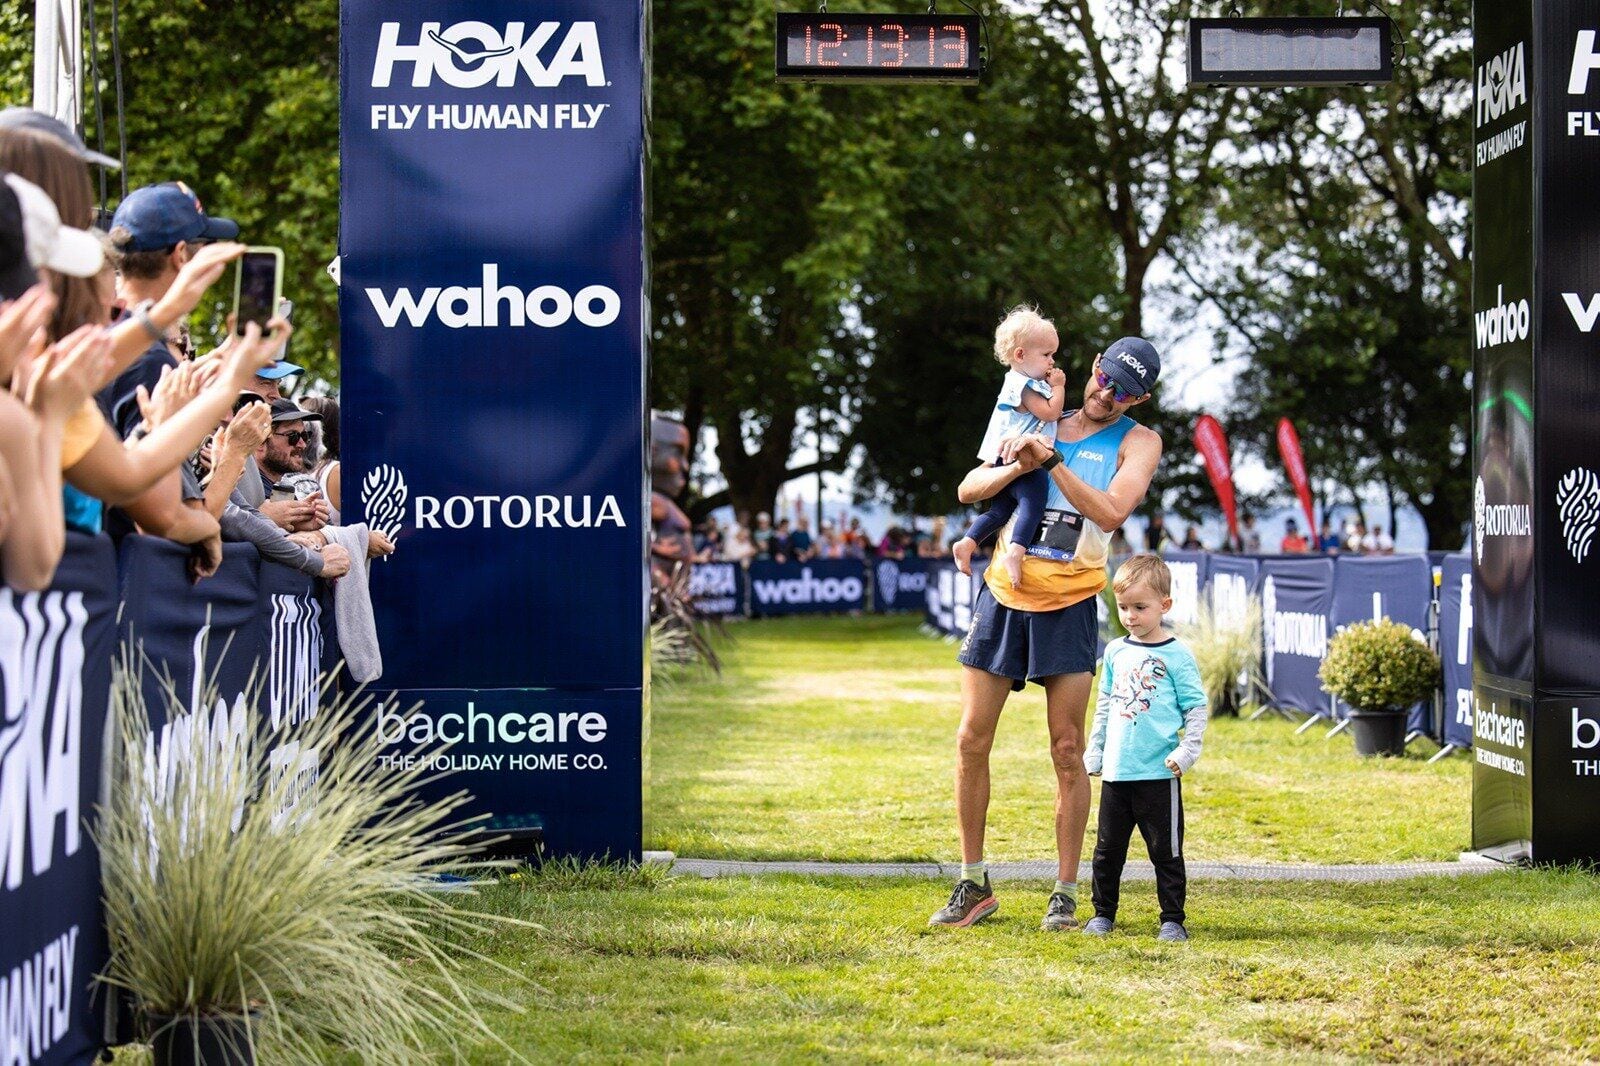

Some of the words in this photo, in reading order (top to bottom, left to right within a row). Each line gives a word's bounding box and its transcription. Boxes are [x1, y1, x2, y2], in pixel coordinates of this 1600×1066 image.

[371, 21, 605, 88] HOKA
[806, 24, 965, 68] 12:13:13
[1476, 41, 1527, 128] HOKA
[371, 105, 421, 129] FLY
[428, 104, 548, 129] HUMAN
[1567, 112, 1600, 136] FL
[1476, 140, 1488, 167] FLY
[1488, 127, 1513, 161] HUMAN
[1513, 121, 1527, 149] FLY
[364, 263, 621, 328] wahoo
[1475, 284, 1530, 349] wahoo
[1117, 351, 1147, 379] HOKA
[1077, 450, 1104, 462] HOKA
[415, 495, 626, 529] ROTORUA
[1486, 504, 1531, 536] ROTORUA
[753, 567, 863, 604] wahoo
[377, 702, 608, 743] bachcare
[1476, 698, 1525, 749] bachcare
[378, 756, 415, 770] THE
[421, 754, 504, 770] HOLIDAY
[509, 754, 568, 770] HOME
[573, 753, 608, 770] CO.
[1572, 760, 1600, 775] TH
